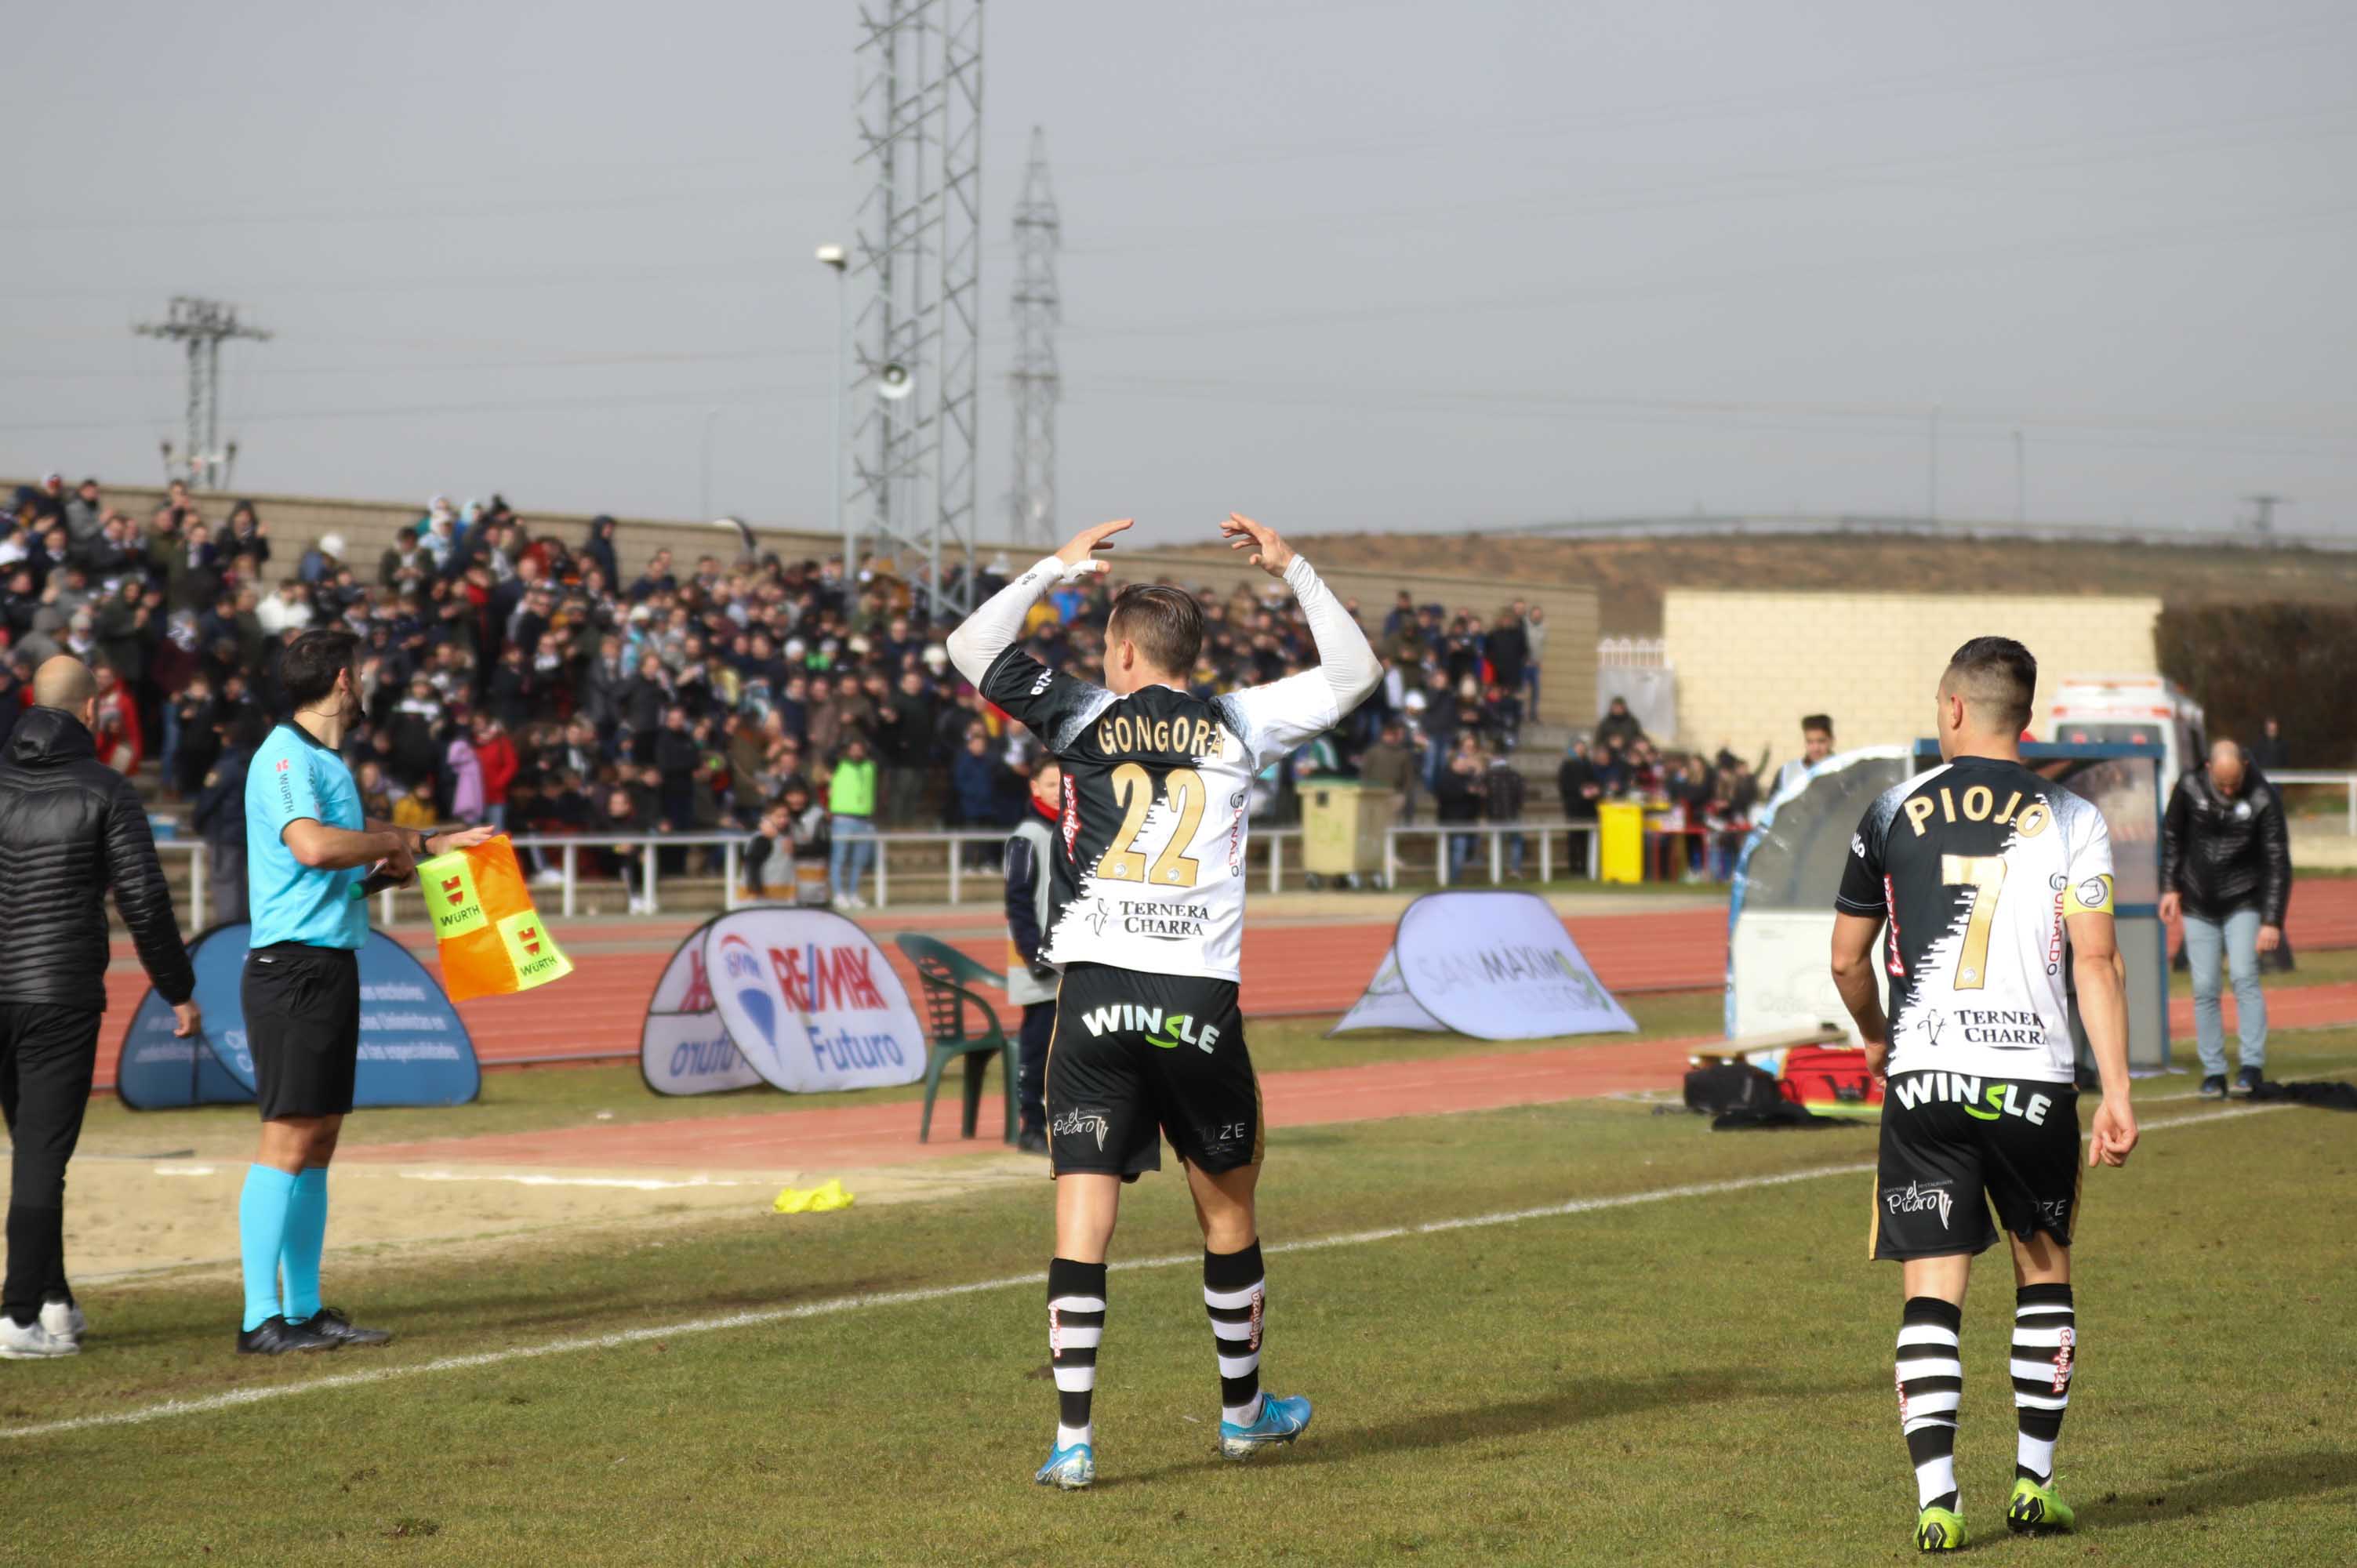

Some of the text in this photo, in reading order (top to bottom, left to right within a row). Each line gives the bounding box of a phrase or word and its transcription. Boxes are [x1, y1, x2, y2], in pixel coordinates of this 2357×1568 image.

[1098, 715, 1225, 760] GONGORA
[278, 773, 296, 814] WÜRTH
[1904, 786, 2050, 838] PIOJO
[1096, 762, 1206, 887] 22
[439, 904, 481, 927] WÜRTH
[1119, 900, 1211, 921] TERNERA
[1124, 916, 1204, 936] CHARRA
[1941, 854, 2008, 991] 7
[520, 955, 557, 977] WÜRTH
[767, 942, 889, 1014] RE/MAX
[1953, 1009, 2046, 1029] TERNER
[804, 1025, 904, 1072] Futuro
[1906, 1180, 1920, 1200] el
